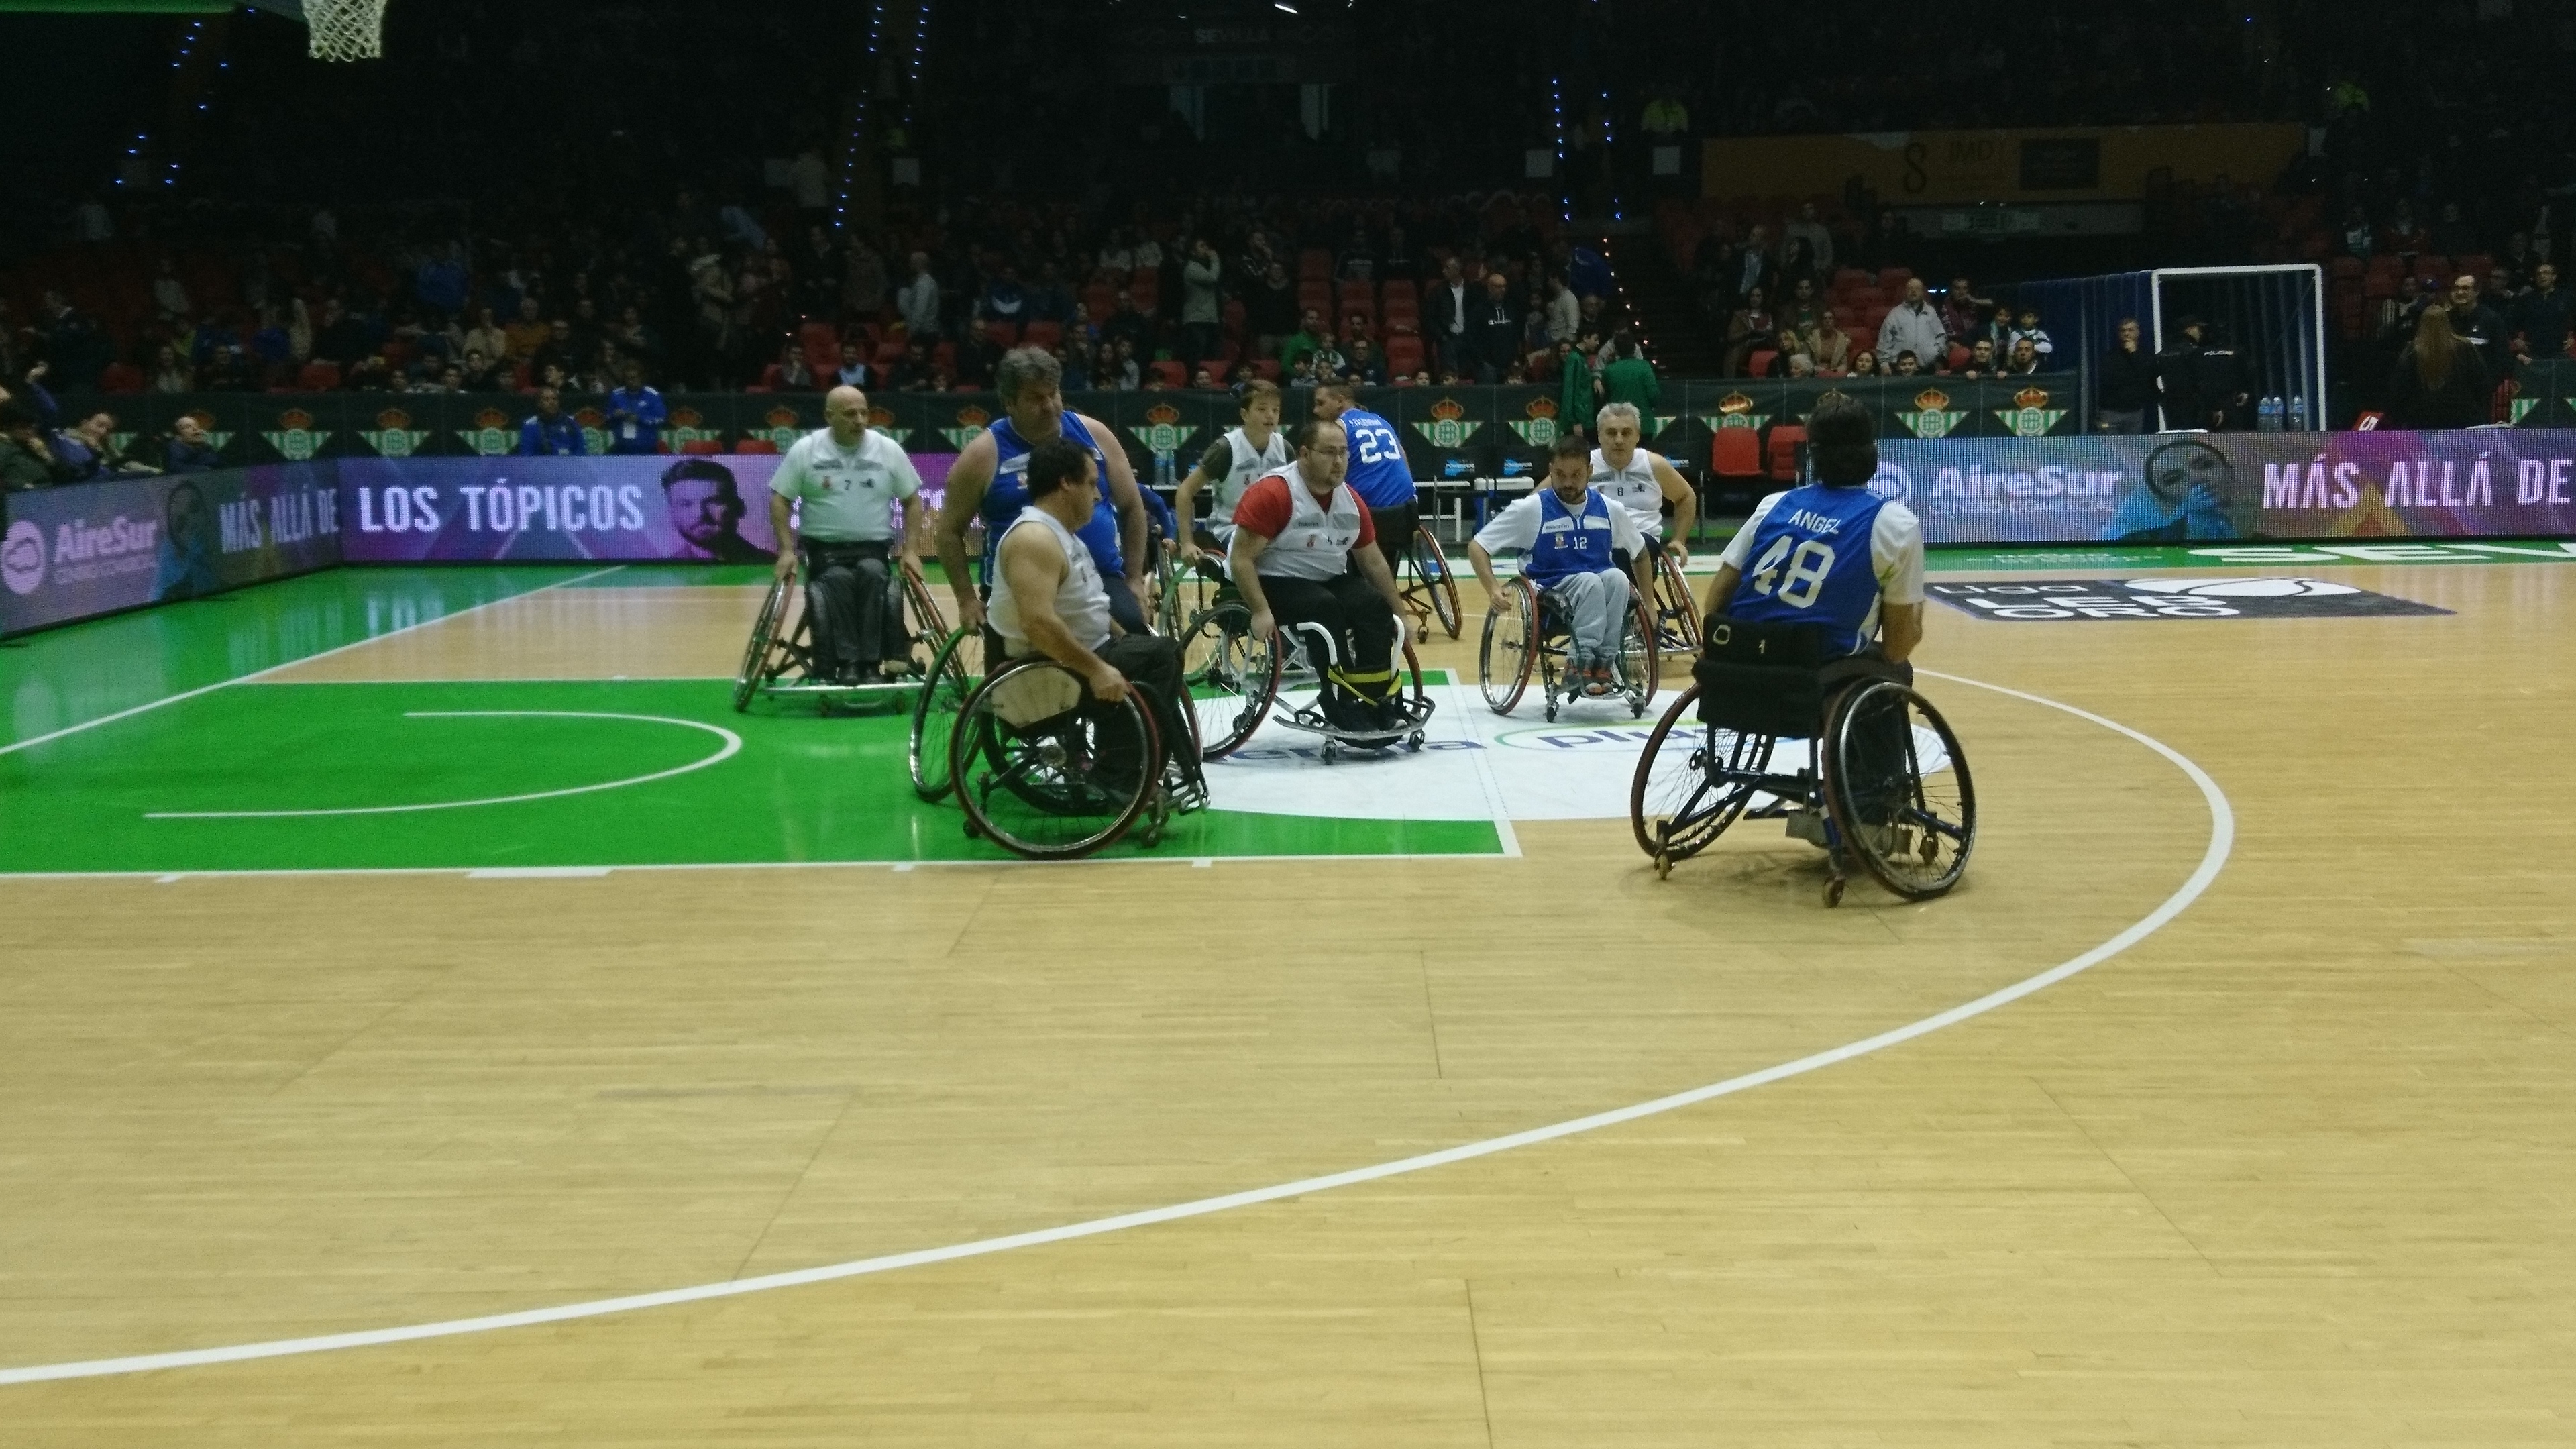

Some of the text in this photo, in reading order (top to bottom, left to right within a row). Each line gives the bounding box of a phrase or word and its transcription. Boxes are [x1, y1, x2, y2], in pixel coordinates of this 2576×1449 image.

[1355, 428, 1401, 464] 23
[1617, 487, 1624, 497] 8
[1930, 464, 2123, 498] AireSur
[2263, 451, 2573, 510] MÁS ALLÁ DE
[219, 483, 339, 554] MÁS ALLÁ DE
[358, 478, 644, 533] LOS TÓPICOS
[1788, 508, 1841, 535] ANGEL
[54, 515, 158, 563] AireSur
[1574, 536, 1587, 549] 12
[1752, 535, 1836, 609] 48
[1966, 595, 2227, 609] LEB
[1993, 606, 2241, 619] ORO
